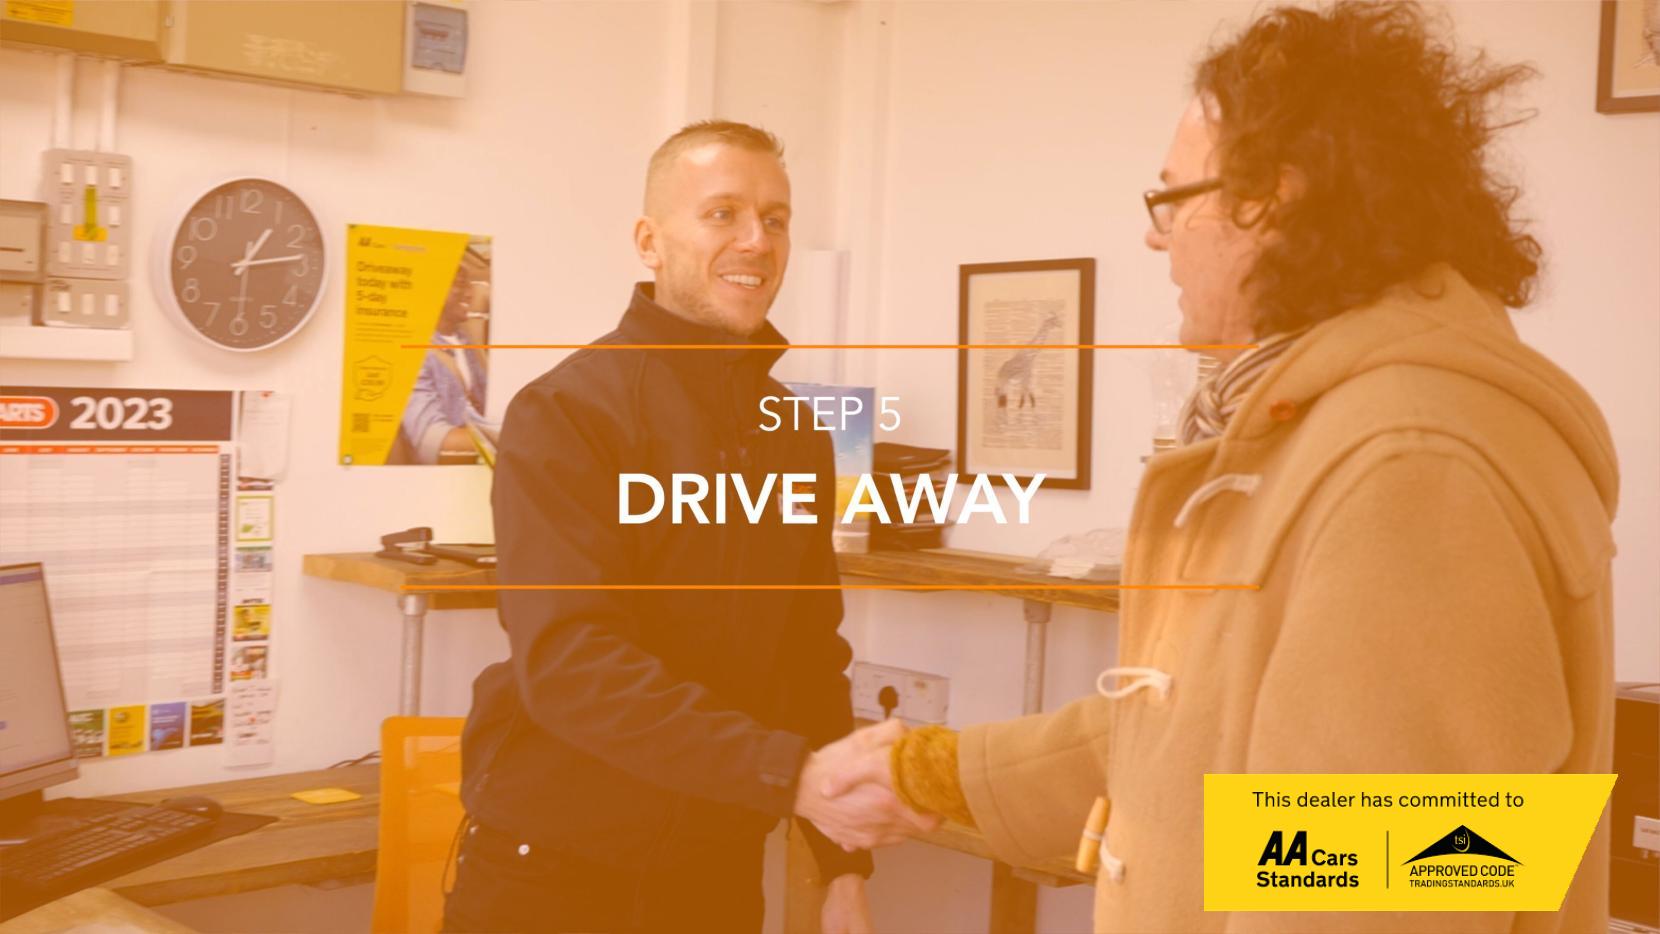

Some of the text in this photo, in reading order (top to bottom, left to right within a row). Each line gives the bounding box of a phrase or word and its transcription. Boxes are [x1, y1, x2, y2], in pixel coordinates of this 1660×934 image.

[215, 195, 235, 220] 11
[240, 188, 264, 214] 12
[274, 201, 284, 225] 1
[188, 217, 218, 241] 10
[286, 224, 306, 249] 2
[177, 246, 197, 270] 9
[181, 278, 201, 303] 8
[281, 283, 298, 305] 4
[203, 302, 221, 327] 7
[229, 311, 249, 336] 6
[258, 304, 278, 329] 5
[69, 396, 173, 430] 2023
